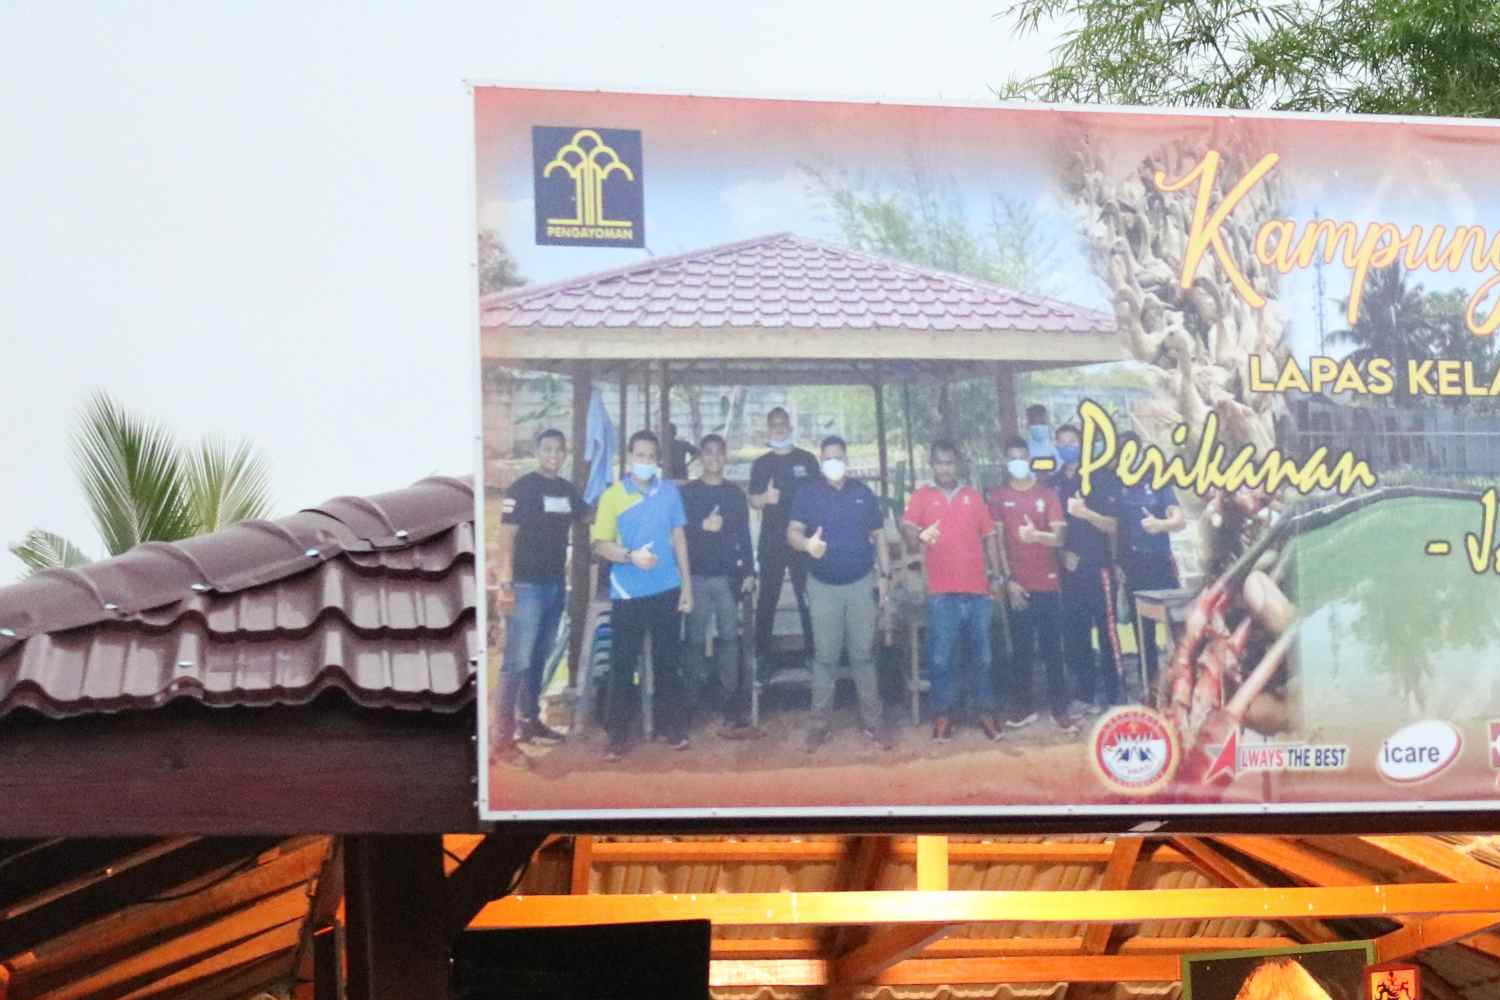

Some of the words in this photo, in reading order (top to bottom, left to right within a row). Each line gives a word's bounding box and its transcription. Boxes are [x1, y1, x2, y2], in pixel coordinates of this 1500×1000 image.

[546, 226, 634, 240] PENGAYOMAN
[1249, 355, 1394, 395] LAPAS
[1078, 399, 1376, 496] Perikanan
[1287, 748, 1312, 767] THE
[1314, 748, 1346, 767] BEST
[1384, 741, 1440, 763] icare
